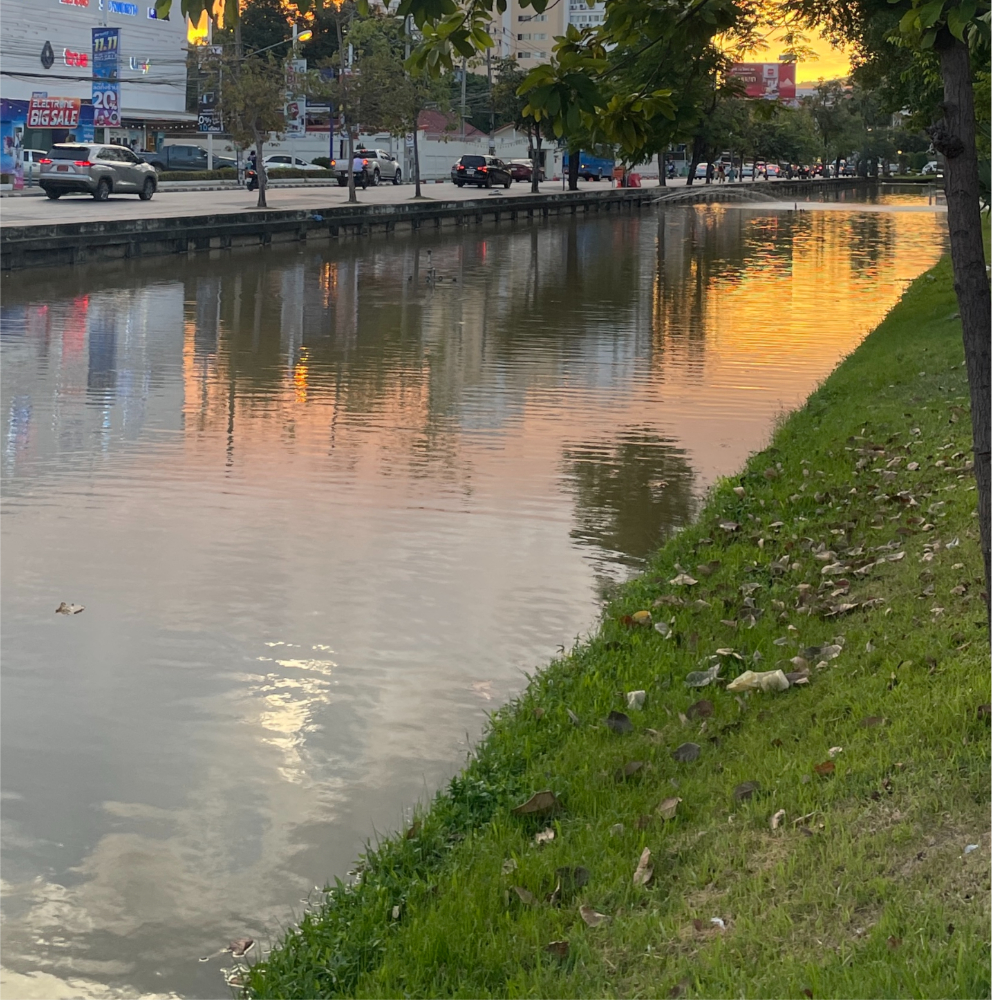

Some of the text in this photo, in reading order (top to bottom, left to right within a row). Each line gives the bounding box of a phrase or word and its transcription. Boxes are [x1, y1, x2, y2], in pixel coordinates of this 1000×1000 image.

[94, 35, 118, 52] 11.11
[63, 47, 88, 68] true
[30, 109, 78, 126] BIG SALE
